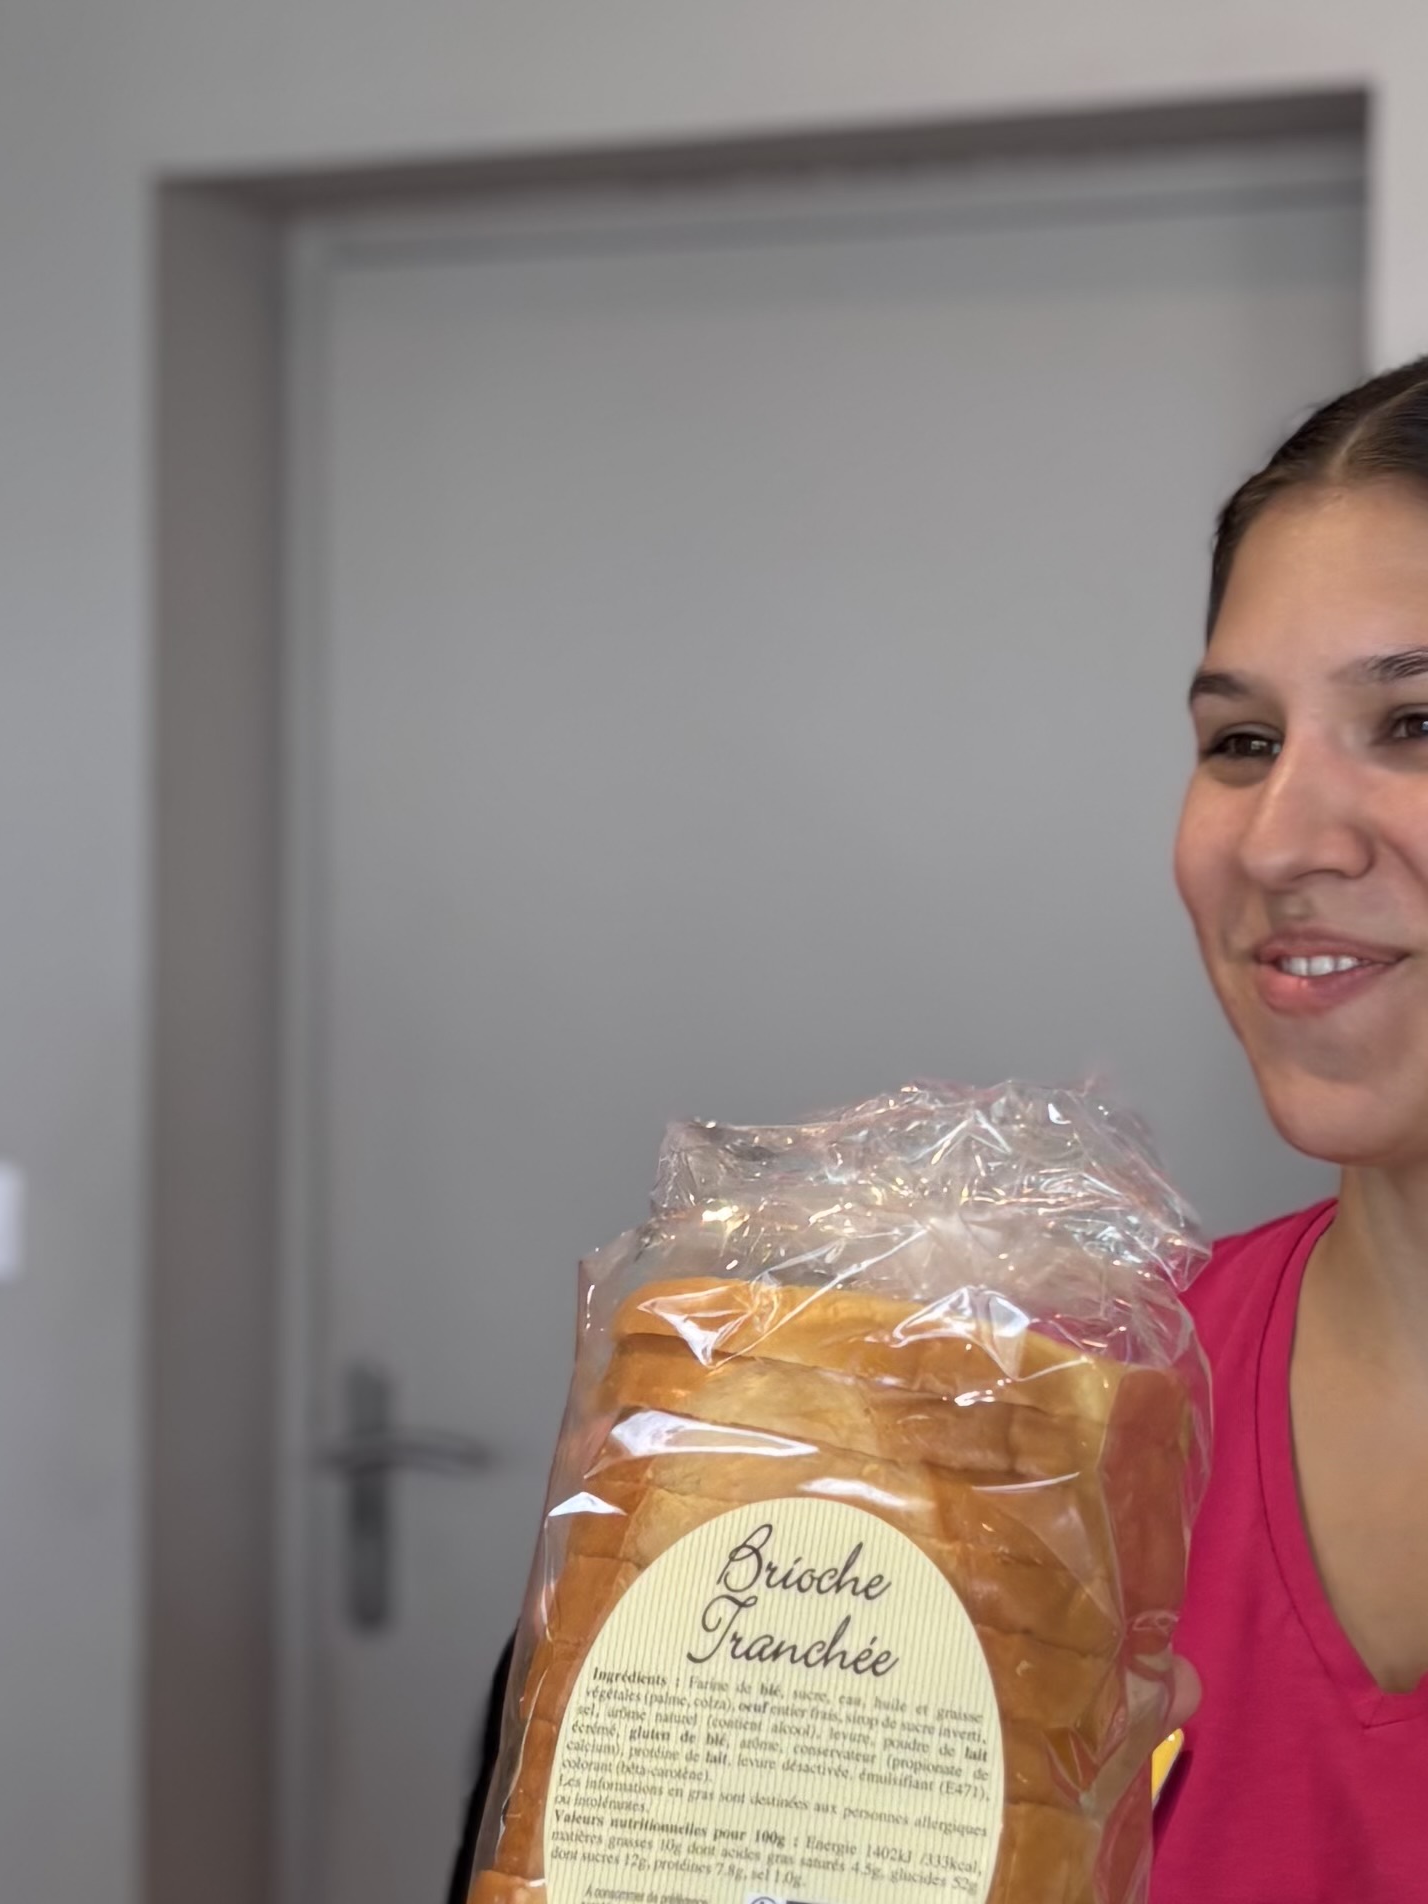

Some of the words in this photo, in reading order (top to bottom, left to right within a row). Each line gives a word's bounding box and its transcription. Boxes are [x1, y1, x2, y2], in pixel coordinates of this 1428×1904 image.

[717, 1524, 892, 1600] Brioche
[687, 1596, 899, 1676] Tranchée
[586, 1686, 641, 1703] végétales
[738, 1702, 769, 1713] oeuf
[770, 1705, 807, 1718] entier
[846, 1713, 879, 1729] sirop
[882, 1716, 897, 1729] de
[901, 1722, 935, 1737] sucre
[593, 1667, 667, 1686] Ingrédients
[689, 1676, 728, 1692] Farine
[736, 1682, 751, 1694] de
[760, 1682, 784, 1699] blé,
[875, 1696, 907, 1712] huile
[916, 1704, 928, 1715] et
[936, 1706, 983, 1723] graisse
[629, 1727, 671, 1742] gluten
[680, 1730, 696, 1744] de
[793, 1744, 876, 1764] conservateur
[887, 1754, 963, 1777] (propionate
[973, 1767, 989, 1781] de
[655, 1710, 698, 1726] naturel
[706, 1714, 762, 1732] (contient
[883, 1735, 929, 1753] poudre
[939, 1745, 955, 1757] de
[964, 1746, 988, 1762] lait
[562, 1757, 612, 1774] colorant
[628, 1744, 680, 1762] protéine
[685, 1748, 700, 1763] de
[737, 1752, 776, 1770] levure
[859, 1770, 933, 1792] émulsifiant
[558, 1774, 580, 1788] Les
[585, 1775, 663, 1796] informations
[668, 1786, 683, 1797] en
[688, 1788, 714, 1804] gras
[720, 1792, 745, 1804] sont
[750, 1792, 808, 1810] destinées
[813, 1801, 837, 1814] aux
[843, 1804, 908, 1825] personnes
[914, 1816, 987, 1838] allergiques
[550, 1846, 578, 1861] dont
[582, 1850, 619, 1864] sucres
[654, 1857, 712, 1875] protéines
[751, 1868, 770, 1881] sel
[551, 1830, 603, 1845] matières
[608, 1834, 653, 1848] grasses
[661, 1839, 682, 1854] 10g
[687, 1841, 716, 1856] dont
[721, 1845, 761, 1860] acides
[766, 1852, 794, 1865] gras
[800, 1855, 845, 1872] saturés
[890, 1870, 947, 1887] glucides
[951, 1875, 978, 1895] 52g
[554, 1810, 604, 1827] Valeurs
[610, 1816, 707, 1837] nutritionnelles
[713, 1827, 747, 1842] pour
[755, 1828, 785, 1846] 100g
[866, 1844, 912, 1864] 1402kJ
